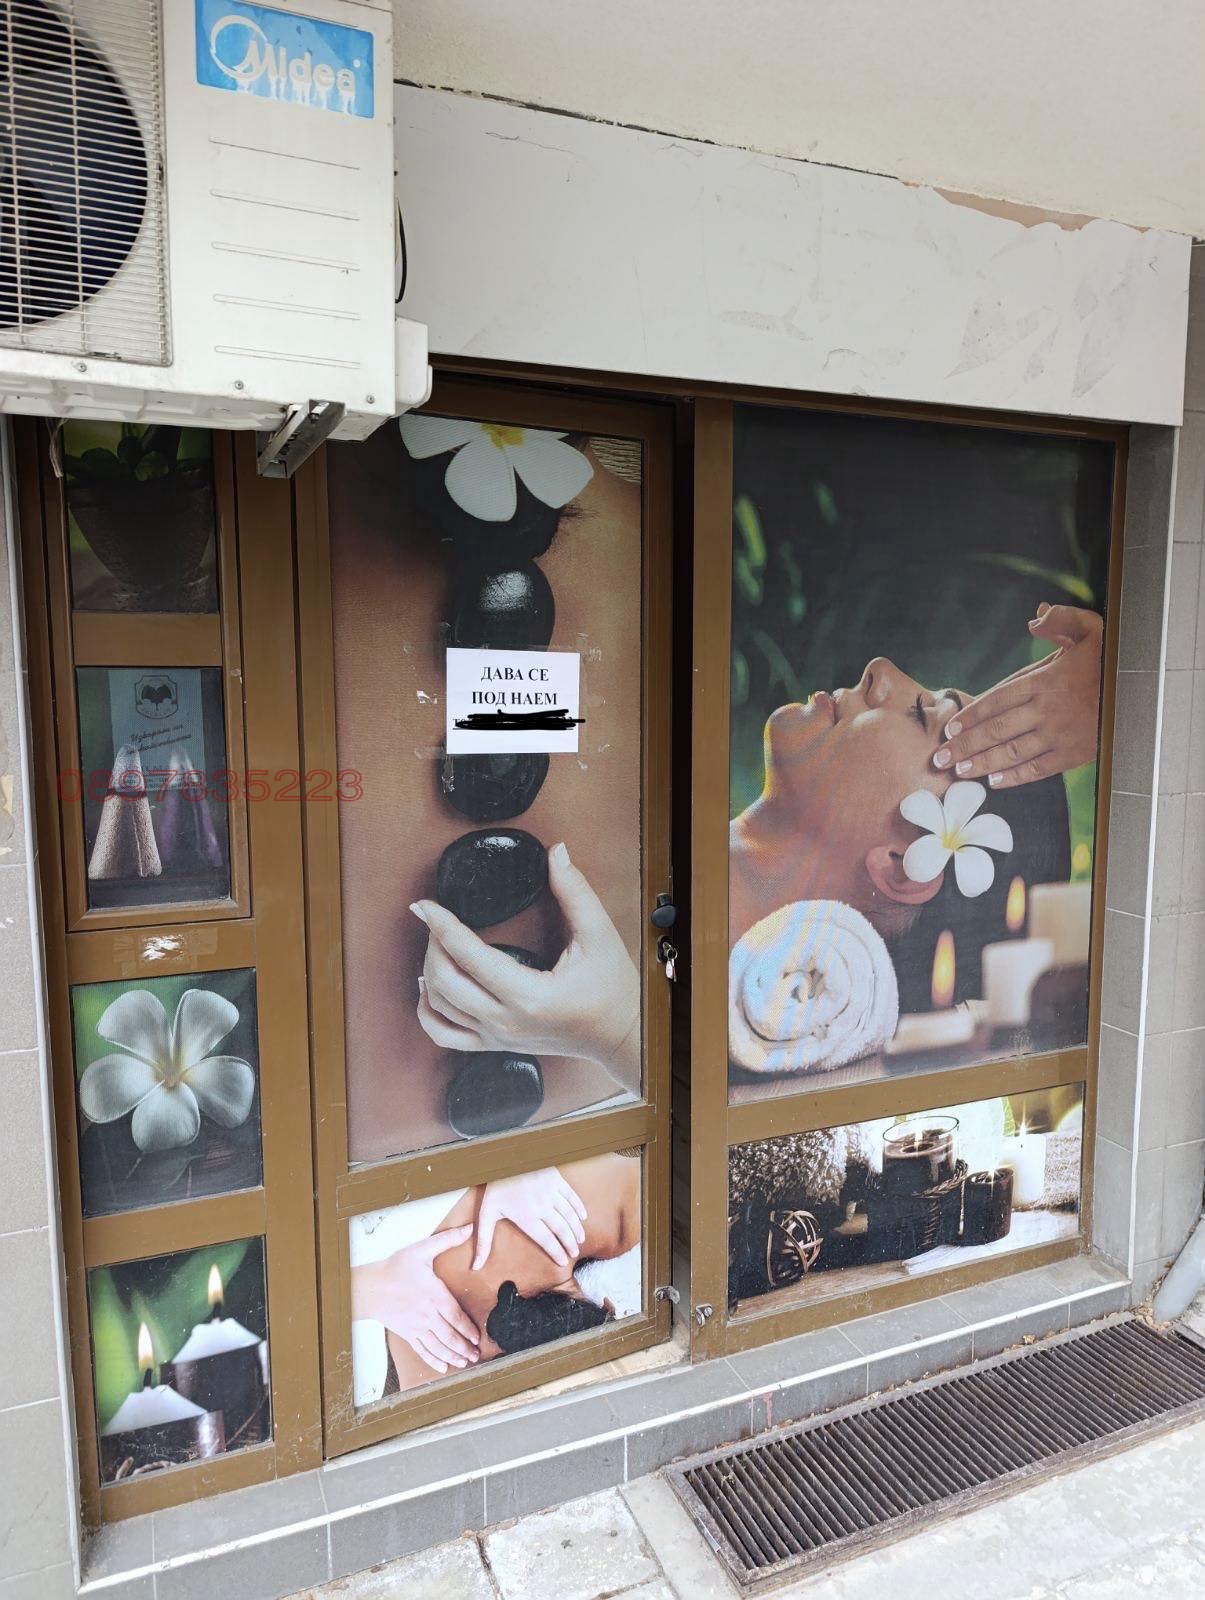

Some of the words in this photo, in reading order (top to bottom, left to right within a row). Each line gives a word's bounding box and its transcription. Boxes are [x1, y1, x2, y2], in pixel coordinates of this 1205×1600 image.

[211, 14, 356, 98] Midea
[480, 666, 524, 682] ДАВА
[528, 668, 549, 681] СЕ
[472, 691, 506, 706] ПОД
[511, 692, 558, 705] НАЕМ
